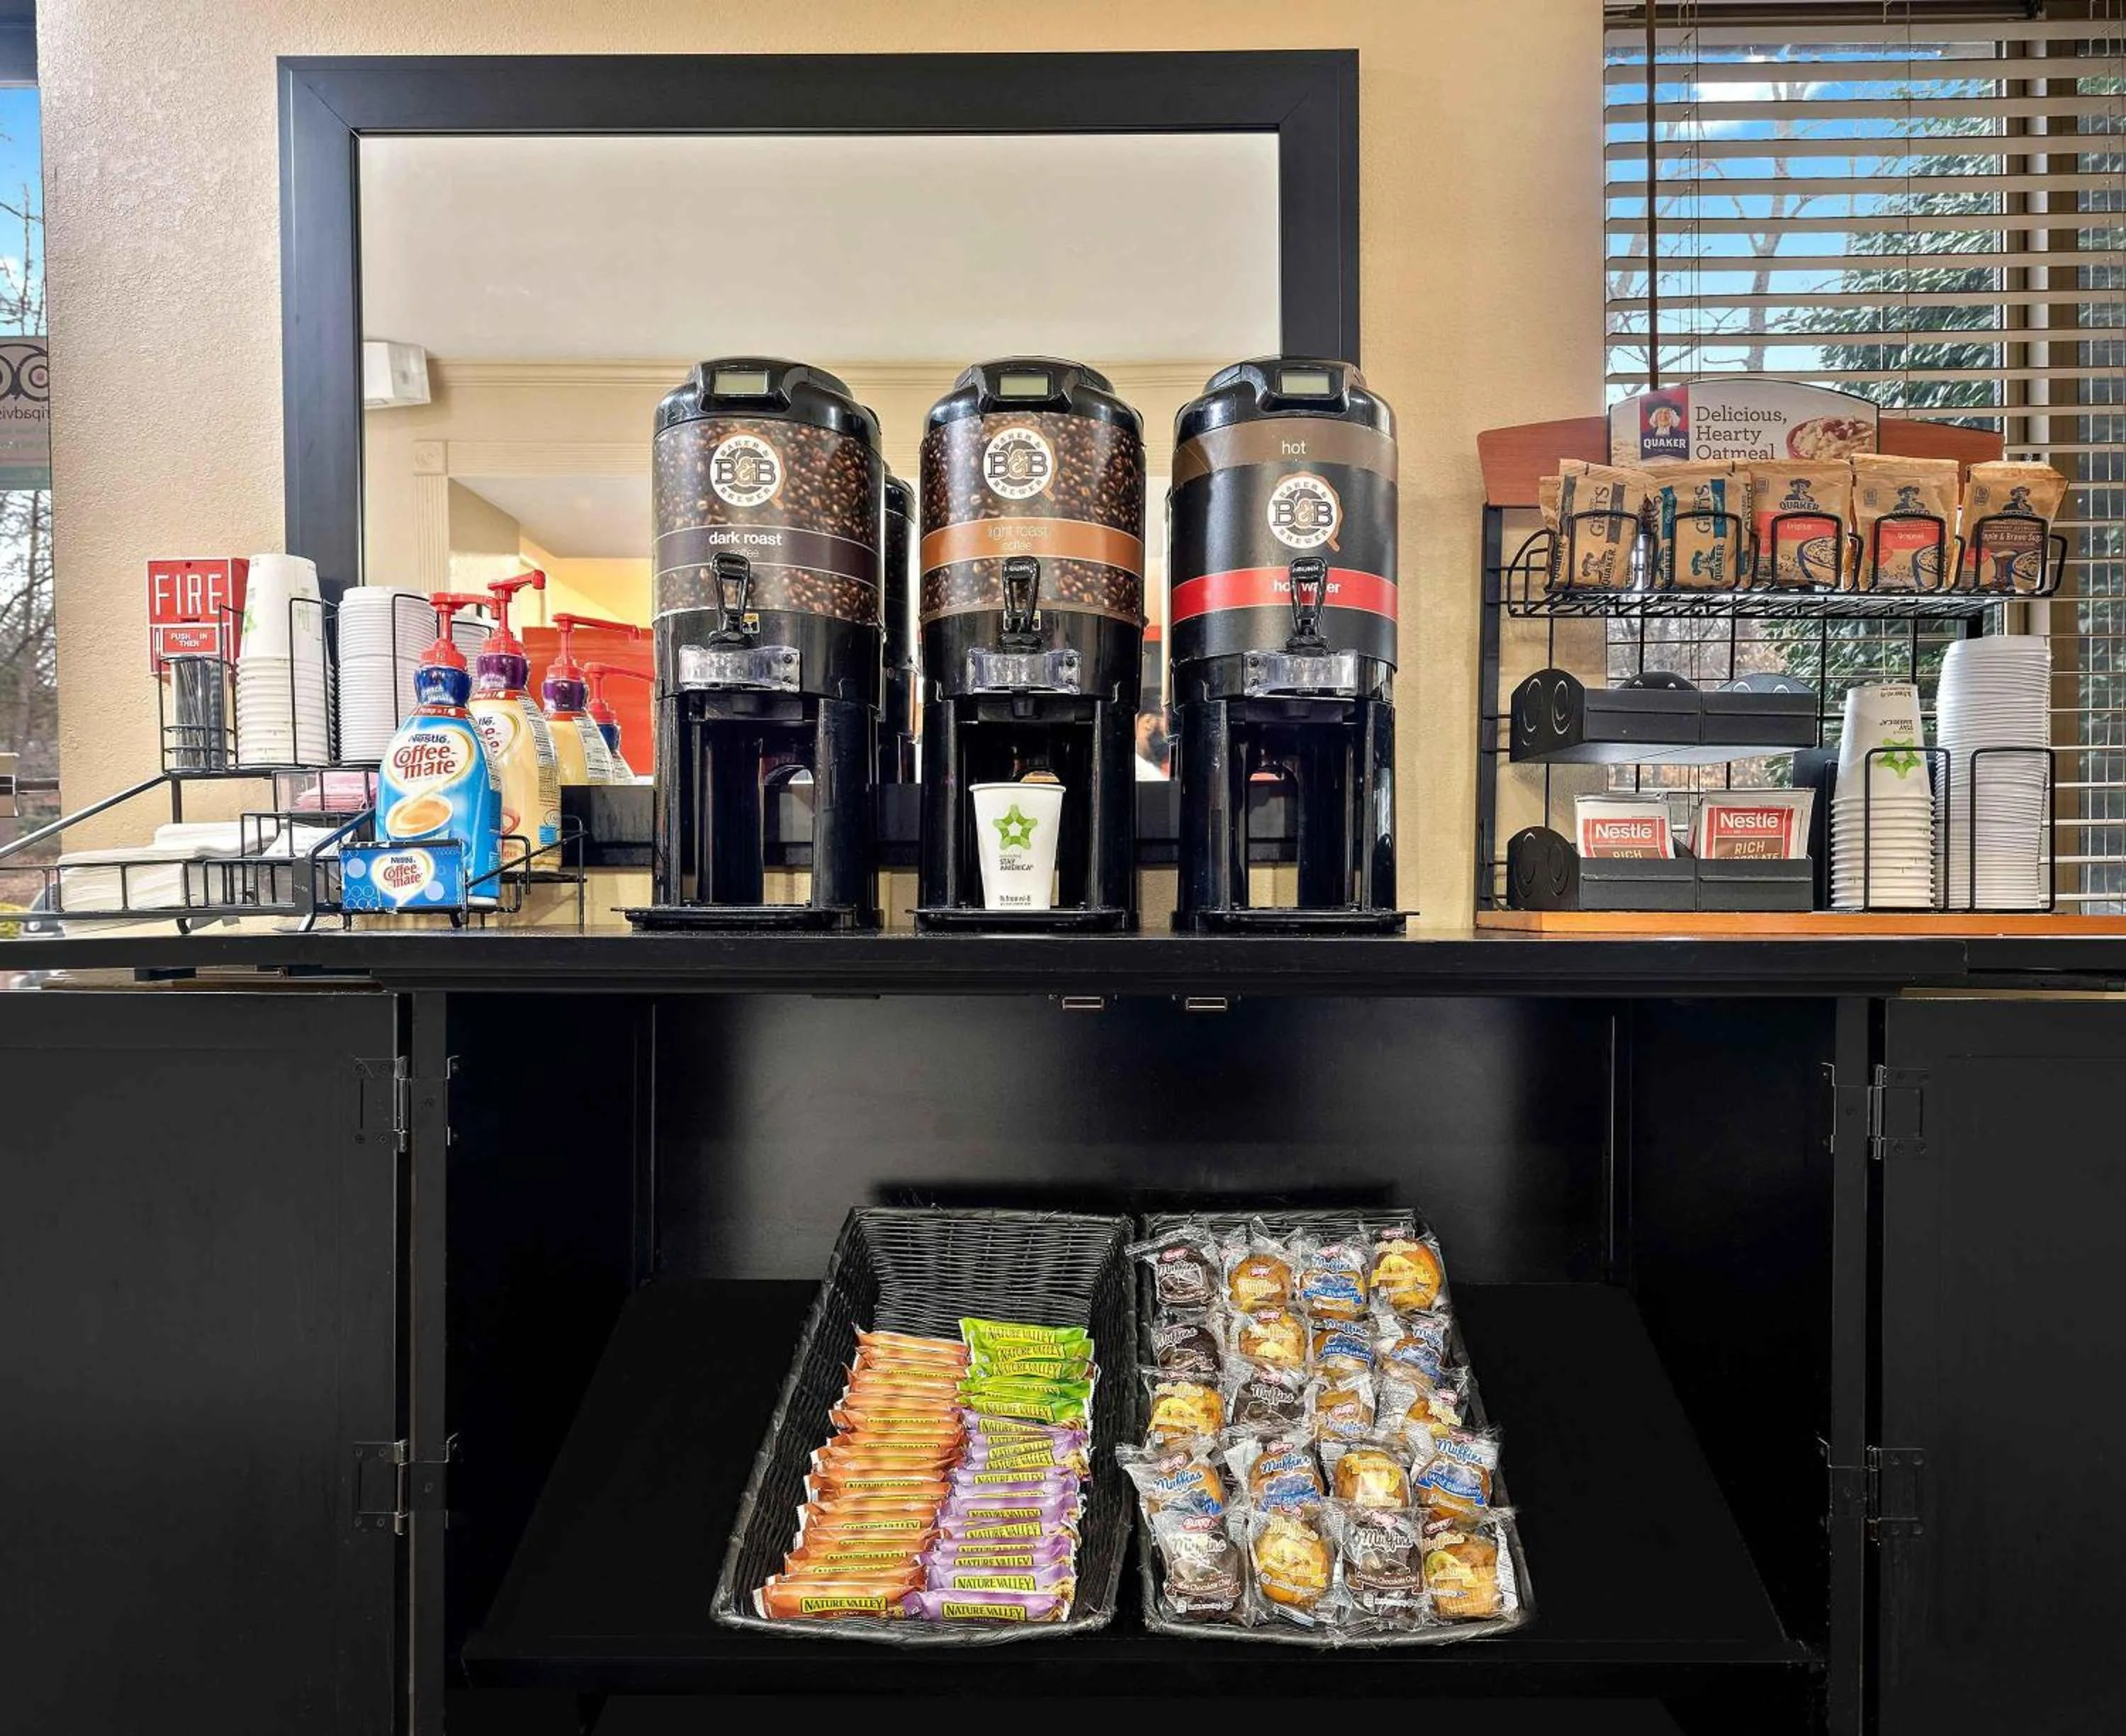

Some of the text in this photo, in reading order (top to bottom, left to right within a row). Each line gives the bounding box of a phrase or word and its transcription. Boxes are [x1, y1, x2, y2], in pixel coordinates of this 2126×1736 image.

[1696, 406, 1787, 424] Delicious,
[1643, 437, 1687, 449] QUAKER
[1697, 426, 1762, 444] Hearty
[1281, 440, 1306, 454] hot
[1697, 444, 1775, 460] Oatmeal
[714, 458, 777, 485] B&B
[987, 451, 1048, 478] B&B
[1272, 500, 1334, 526] B&B
[1779, 501, 1819, 511] QUAKER
[709, 531, 782, 546] dark roast
[987, 524, 1012, 540] ight
[1983, 532, 1998, 541] aple
[2028, 534, 2042, 542] Sug
[1601, 549, 1616, 586] QUAKER
[1714, 544, 1724, 581] QUAKER
[154, 574, 223, 615] FIRE
[1273, 580, 1341, 594] ho waer
[403, 760, 456, 779] mate
[1721, 812, 1779, 829] Nestlé
[1596, 822, 1653, 840] Nestlé
[1734, 841, 1765, 855] RICH
[393, 873, 422, 889] mate
[1436, 1439, 1483, 1465] Muffins
[1261, 1455, 1310, 1473] Muffins
[1156, 1470, 1203, 1489] Muffins
[1429, 1473, 1446, 1484] Wild
[1360, 1528, 1414, 1552] Muffins
[957, 1577, 1033, 1589] NATURE VALLEY
[804, 1597, 883, 1611] NATURE VALLEY
[945, 1604, 1023, 1619] NATURE VALLEY
